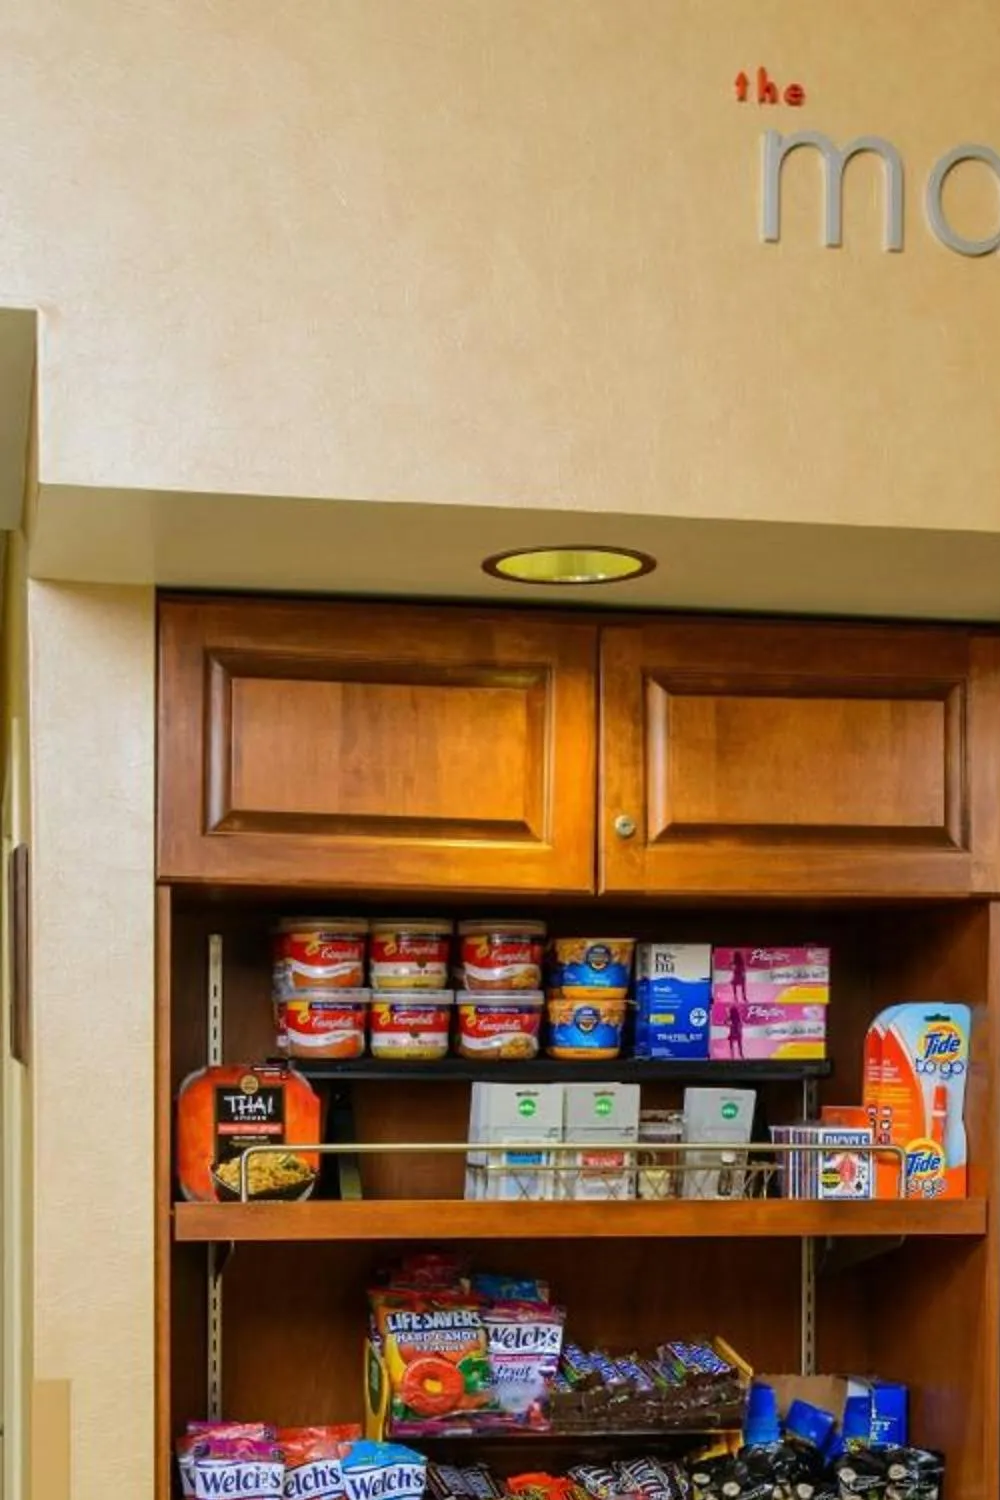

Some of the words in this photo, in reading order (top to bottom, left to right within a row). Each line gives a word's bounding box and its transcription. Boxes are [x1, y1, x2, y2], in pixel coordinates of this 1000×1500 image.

[735, 67, 805, 107] the
[924, 1031, 962, 1059] Tide
[915, 1058, 936, 1075] to
[939, 1060, 965, 1080] go
[224, 1094, 274, 1114] THAI
[906, 1152, 942, 1178] Tide
[284, 1464, 341, 1498] elch's
[349, 1466, 425, 1500] Welch's
